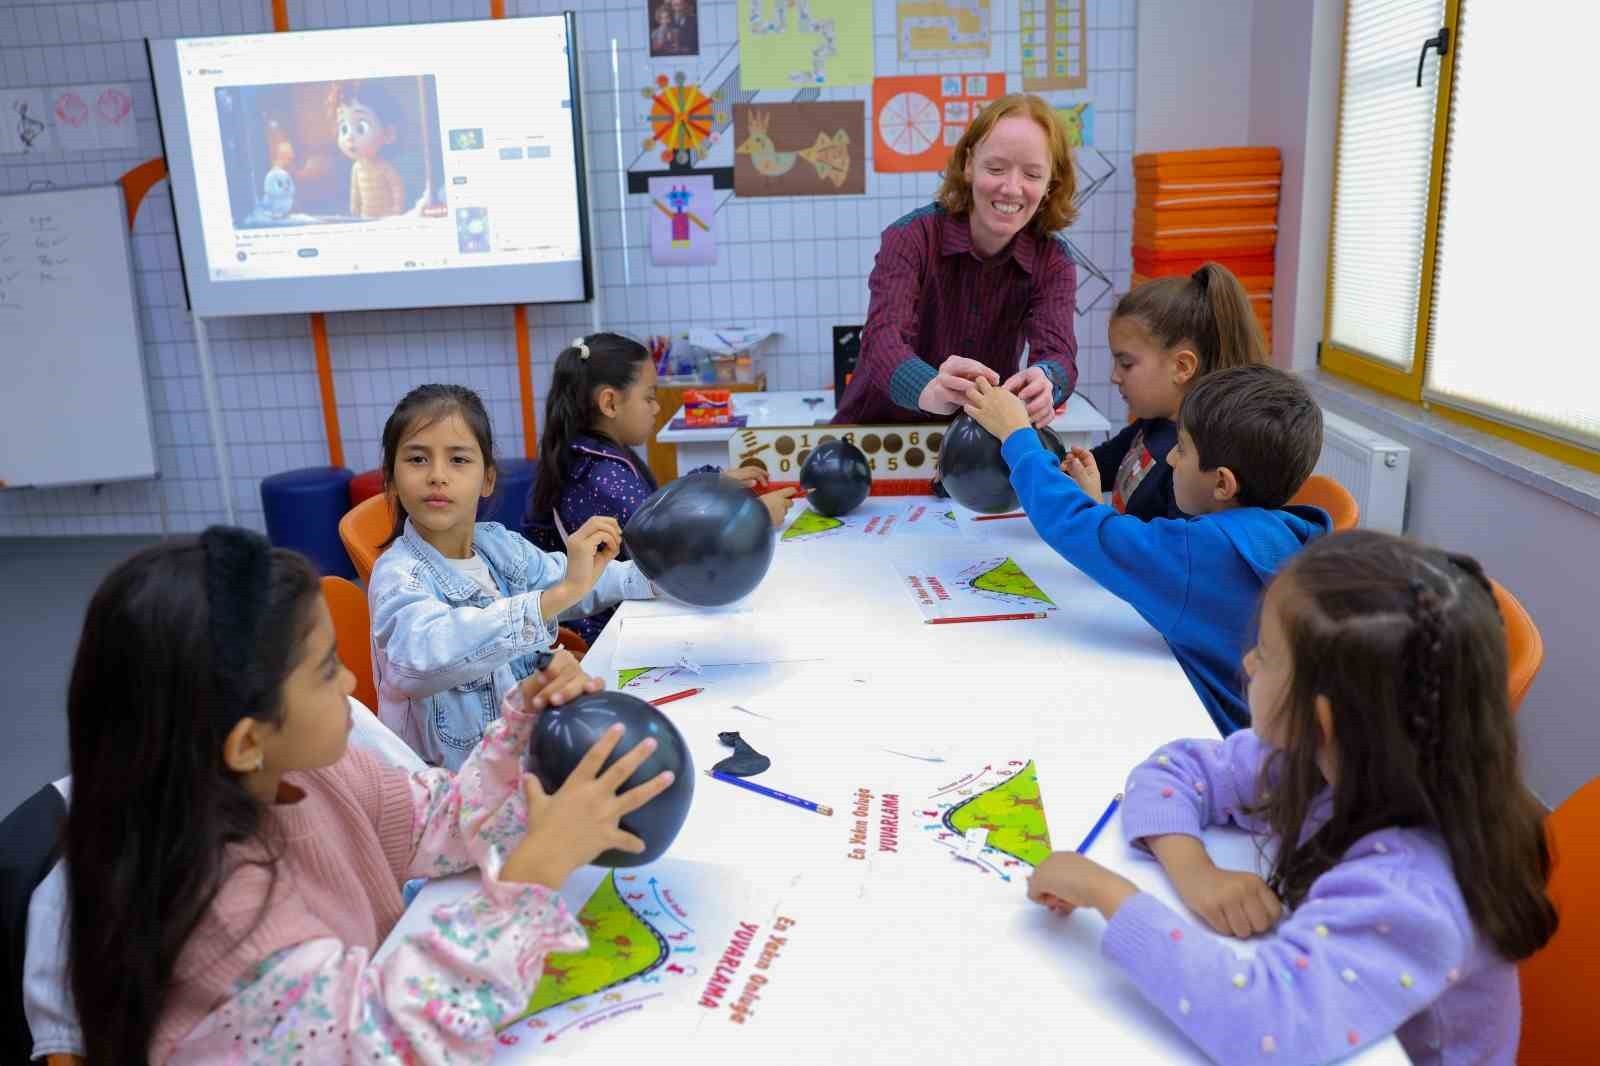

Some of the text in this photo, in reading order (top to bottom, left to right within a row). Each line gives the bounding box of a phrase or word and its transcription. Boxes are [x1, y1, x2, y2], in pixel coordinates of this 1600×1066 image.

[802, 434, 812, 447] 1
[908, 432, 920, 446] 6
[780, 458, 791, 472] 0
[887, 457, 898, 471] 5
[879, 793, 899, 853] YUVARLAMA
[847, 847, 866, 861] En
[773, 916, 796, 932] En
[697, 920, 760, 1009] YUVARLAMA
